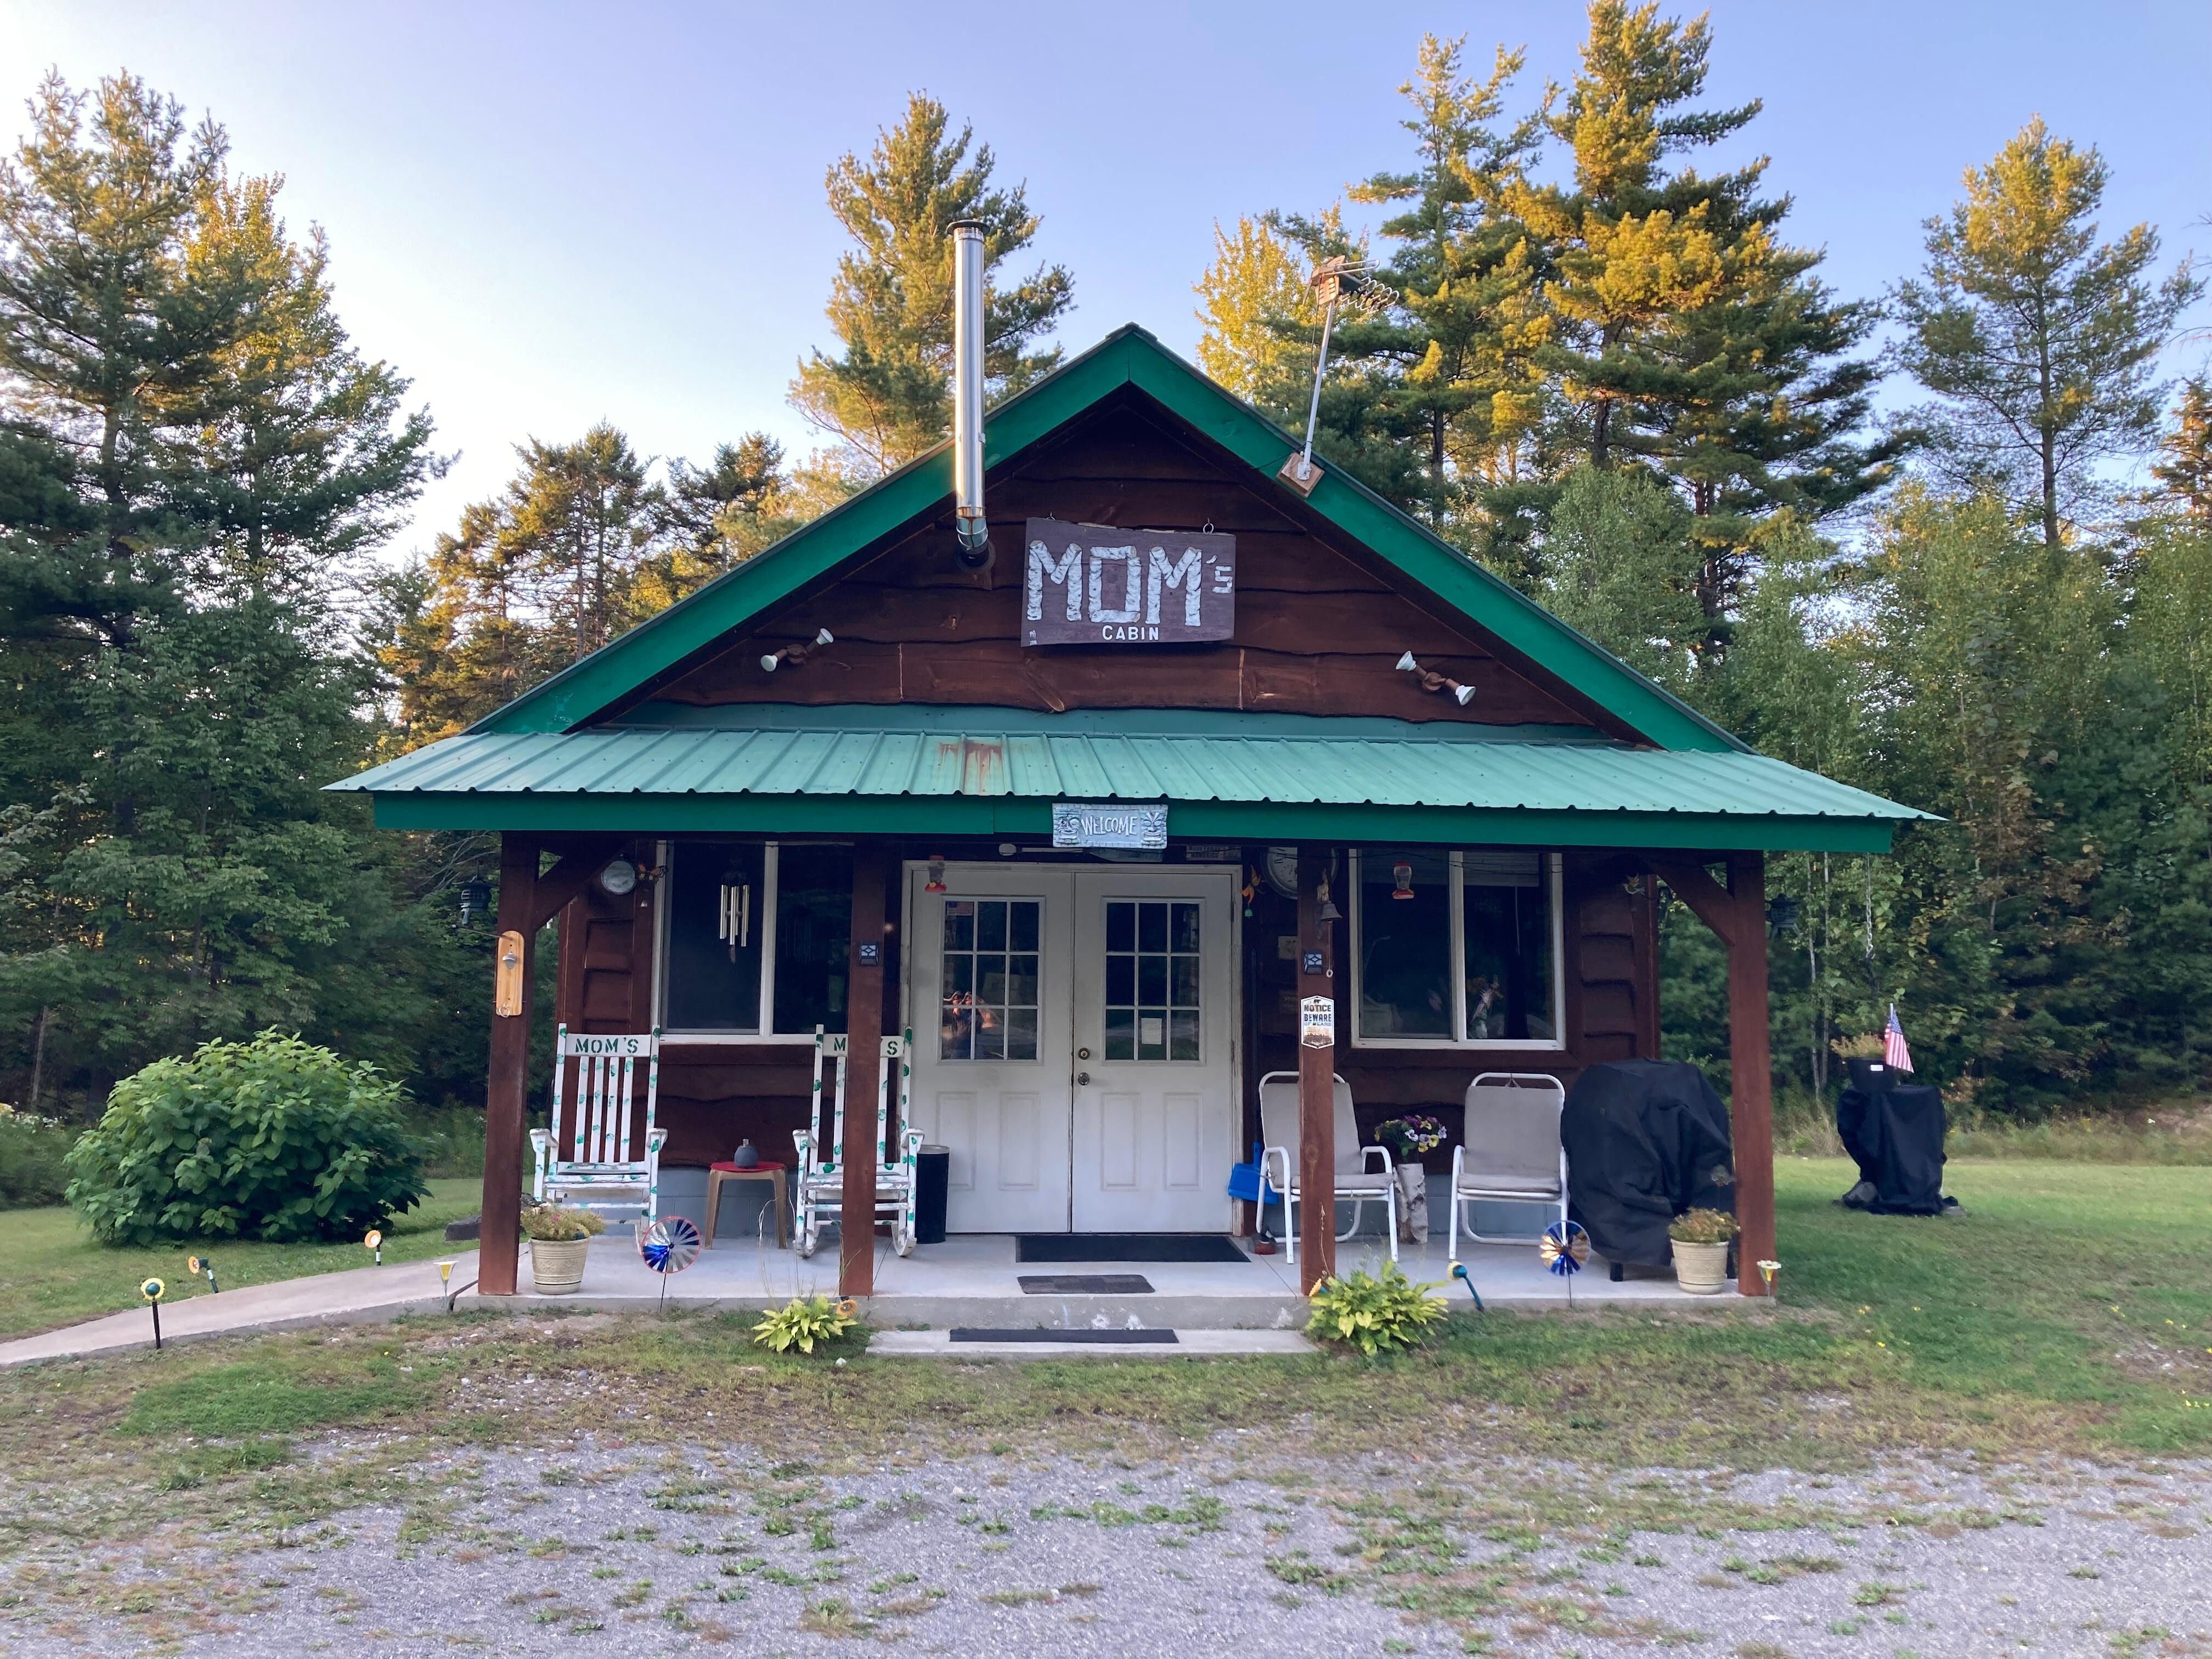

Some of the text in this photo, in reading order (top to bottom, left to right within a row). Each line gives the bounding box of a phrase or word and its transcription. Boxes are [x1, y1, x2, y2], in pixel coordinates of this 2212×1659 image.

[1027, 540, 1232, 627] MOM'S
[1102, 625, 1159, 641] CABIN
[1081, 815, 1138, 836] WELCOME
[1304, 1013, 1331, 1022] BEWARE
[575, 1037, 639, 1053] MOM'S
